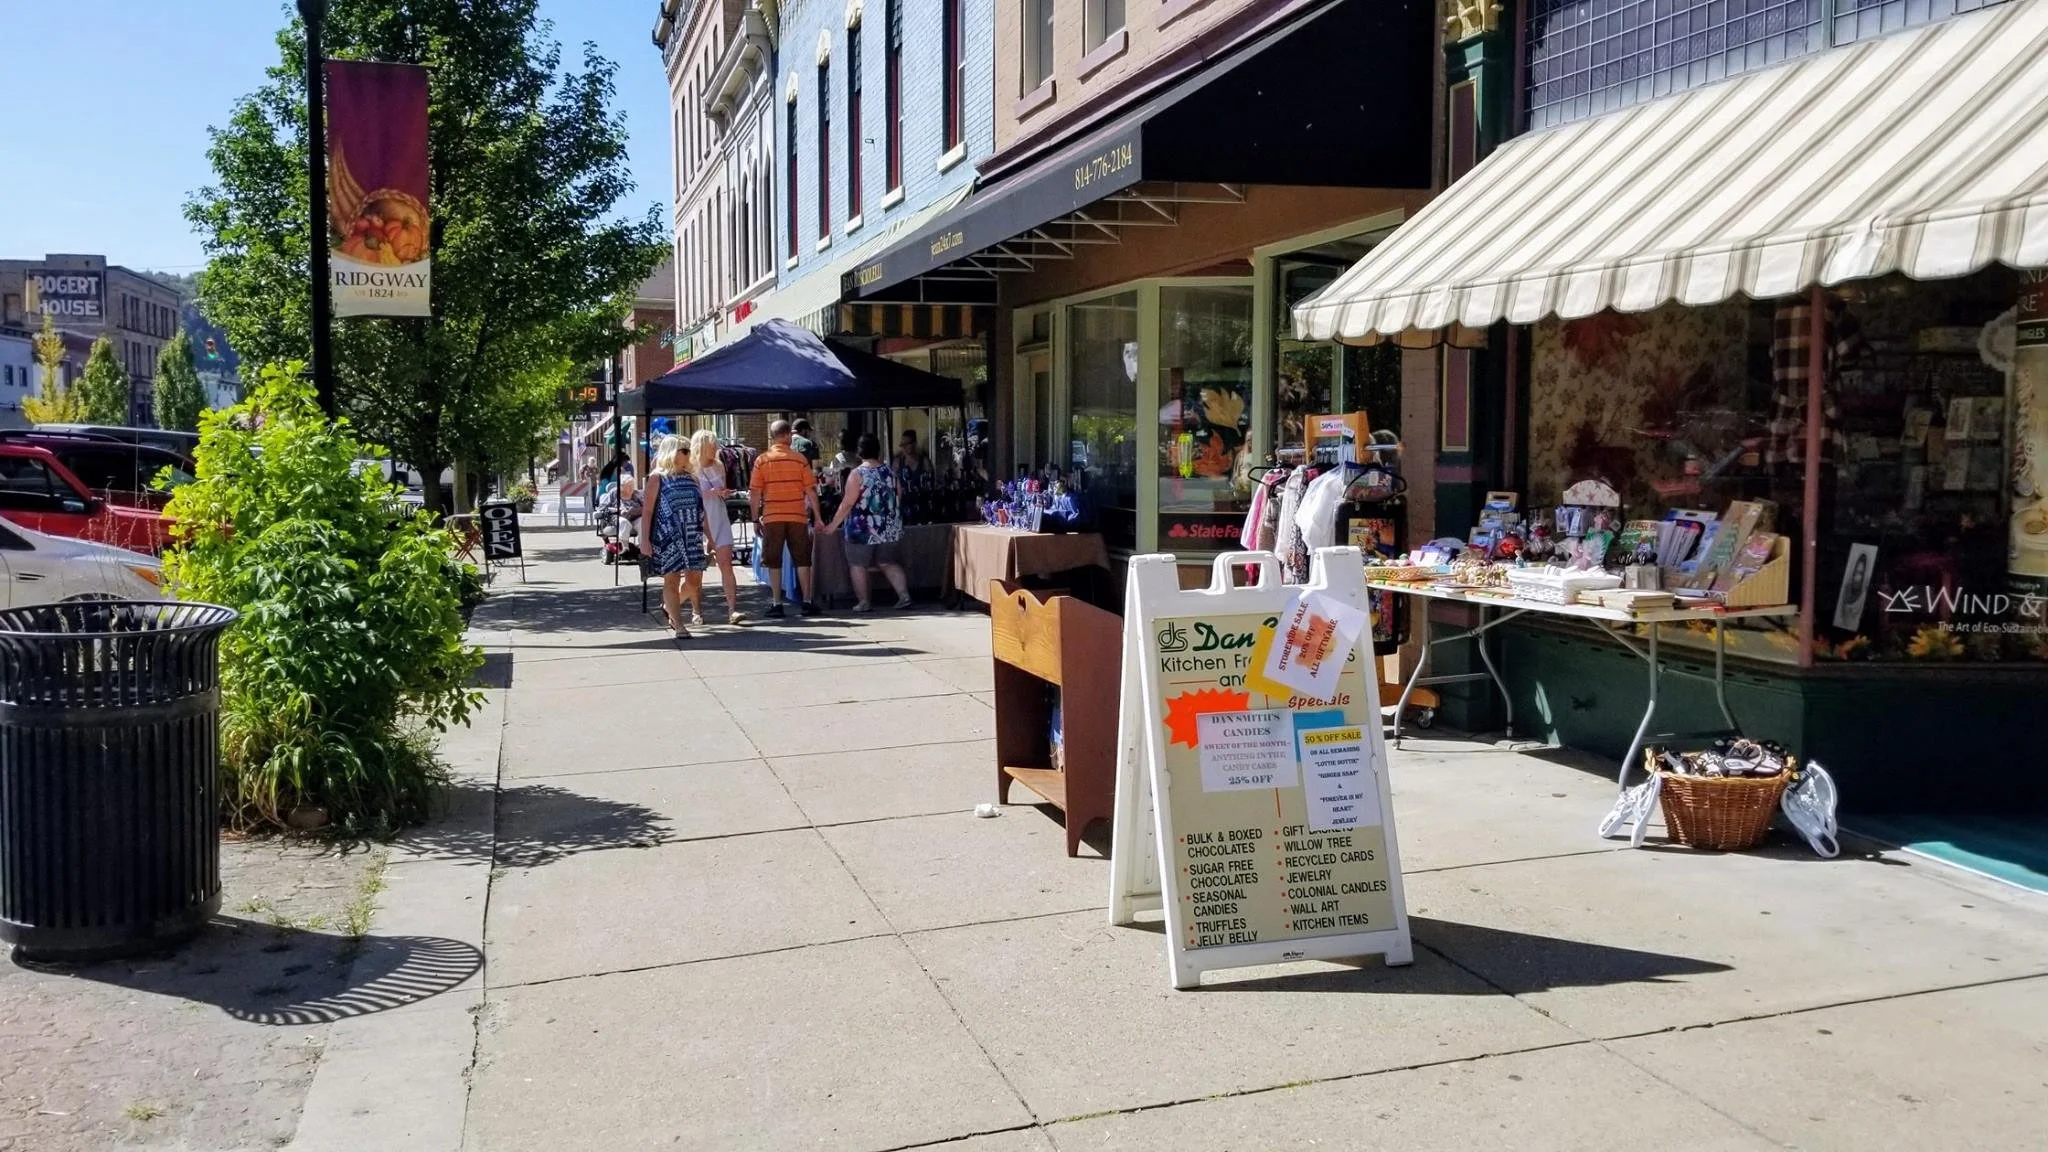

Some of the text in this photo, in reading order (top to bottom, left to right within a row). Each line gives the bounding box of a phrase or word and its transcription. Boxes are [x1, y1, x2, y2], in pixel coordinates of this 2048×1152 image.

[1075, 142, 1132, 190] 814-776-2184
[34, 276, 99, 294] BOGERT
[335, 272, 427, 287] RIDGWAY
[368, 289, 394, 298] 1824
[38, 300, 99, 315] HOUSE
[484, 507, 515, 555] OPEN
[1926, 585, 2043, 617] WIND &
[1306, 626, 1316, 642] OFF
[1938, 621, 1953, 632] The
[1956, 622, 1970, 632] Art
[1972, 621, 1982, 632] of
[1193, 622, 1255, 651] Dan
[1279, 602, 1308, 671] STOREWIDE SALE
[1310, 619, 1338, 678] ALL GIFTWARE
[1161, 657, 1226, 673] Kitchen
[1212, 713, 1280, 724] DAN SMITH'S
[1223, 728, 1271, 737] CANDIES
[1324, 734, 1339, 742] OFF
[1341, 732, 1362, 740] SALE
[1212, 753, 1255, 761] ANYTHING
[1268, 751, 1286, 759] THE
[1228, 774, 1274, 785] 25% OFF
[1187, 828, 1263, 844] BULK & BOXED
[1283, 825, 1304, 836] GIFT
[1188, 842, 1255, 858] CHOCOLATES
[1284, 836, 1352, 852] WILLOW TREE
[1189, 859, 1254, 875] SUGAR FREE
[1286, 850, 1374, 868] RECYCLED CARDS
[1191, 873, 1258, 889] CHOCOLATES
[1287, 869, 1332, 884] JEWELRY
[1193, 888, 1247, 903] SEASONAL
[1288, 880, 1387, 899] COLONIAL CANDLES
[1194, 903, 1238, 917] CANDIES
[1291, 900, 1340, 914] WALL ART
[1196, 918, 1247, 933] TRUFFLES
[1292, 913, 1369, 931] KITCHEN ITEMS
[1197, 930, 1258, 947] JELLY BELLY
